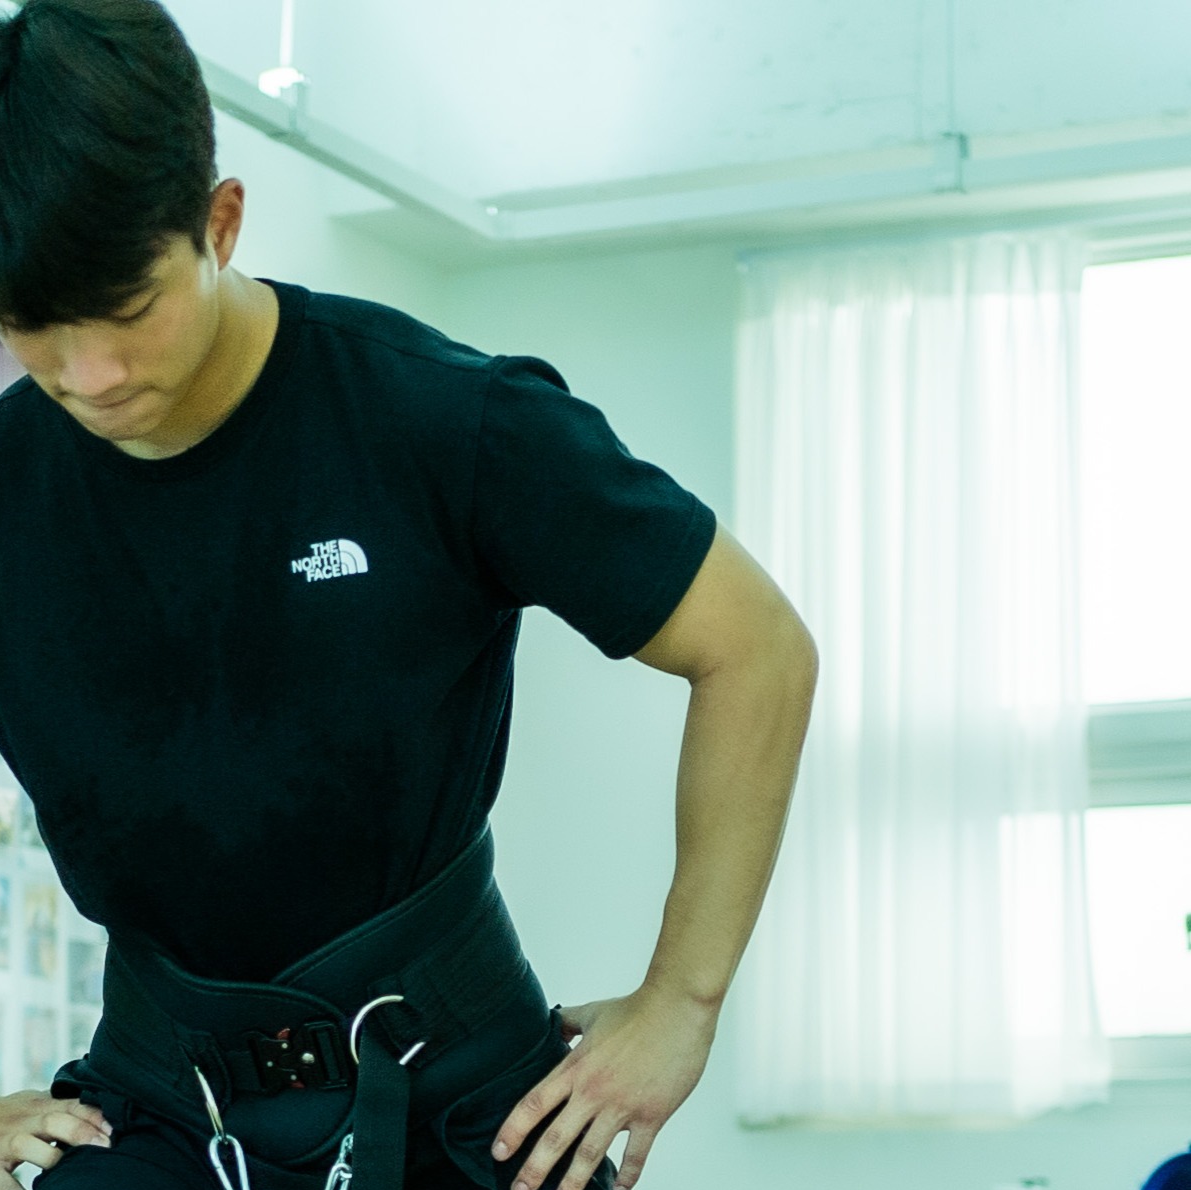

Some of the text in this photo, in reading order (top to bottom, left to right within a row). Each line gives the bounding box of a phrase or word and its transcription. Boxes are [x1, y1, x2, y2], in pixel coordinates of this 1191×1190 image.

[310, 540, 339, 556] THE
[291, 552, 341, 574] NORTH
[306, 564, 342, 583] FACE
